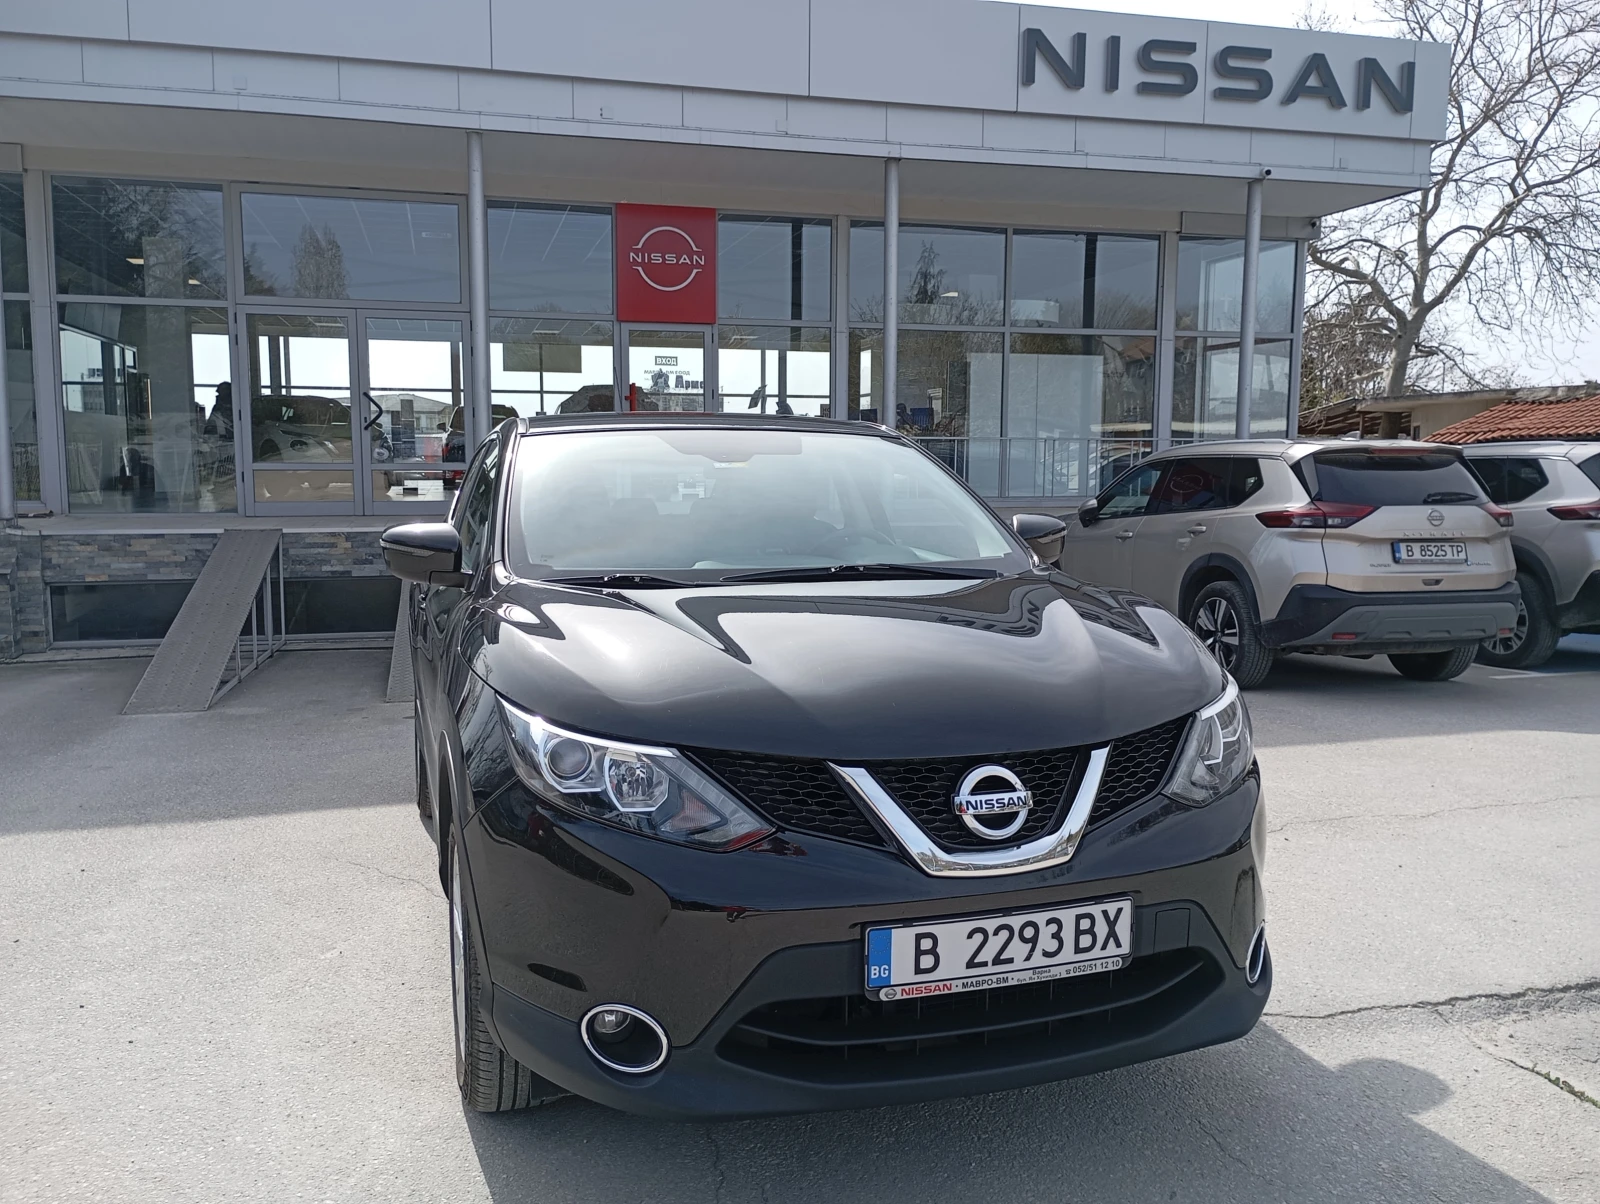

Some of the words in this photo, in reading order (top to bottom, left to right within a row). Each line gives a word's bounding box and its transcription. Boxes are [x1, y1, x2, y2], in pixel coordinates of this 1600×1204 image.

[1022, 27, 1416, 114] NISSAN
[629, 251, 705, 266] NISSAN
[656, 357, 677, 366] ВХОД
[1405, 544, 1414, 557] B
[1420, 544, 1448, 557] 8525
[965, 795, 1027, 811] NISSAN
[914, 931, 941, 975] B
[965, 916, 1064, 970] 2293
[1073, 907, 1124, 955] BX
[870, 965, 889, 978] BG
[1072, 963, 1097, 974] 052/51
[1100, 960, 1109, 969] 12
[1111, 959, 1120, 968] 10
[900, 983, 952, 997] NISSAN
[961, 976, 1009, 990] МАВРО-ВМ
